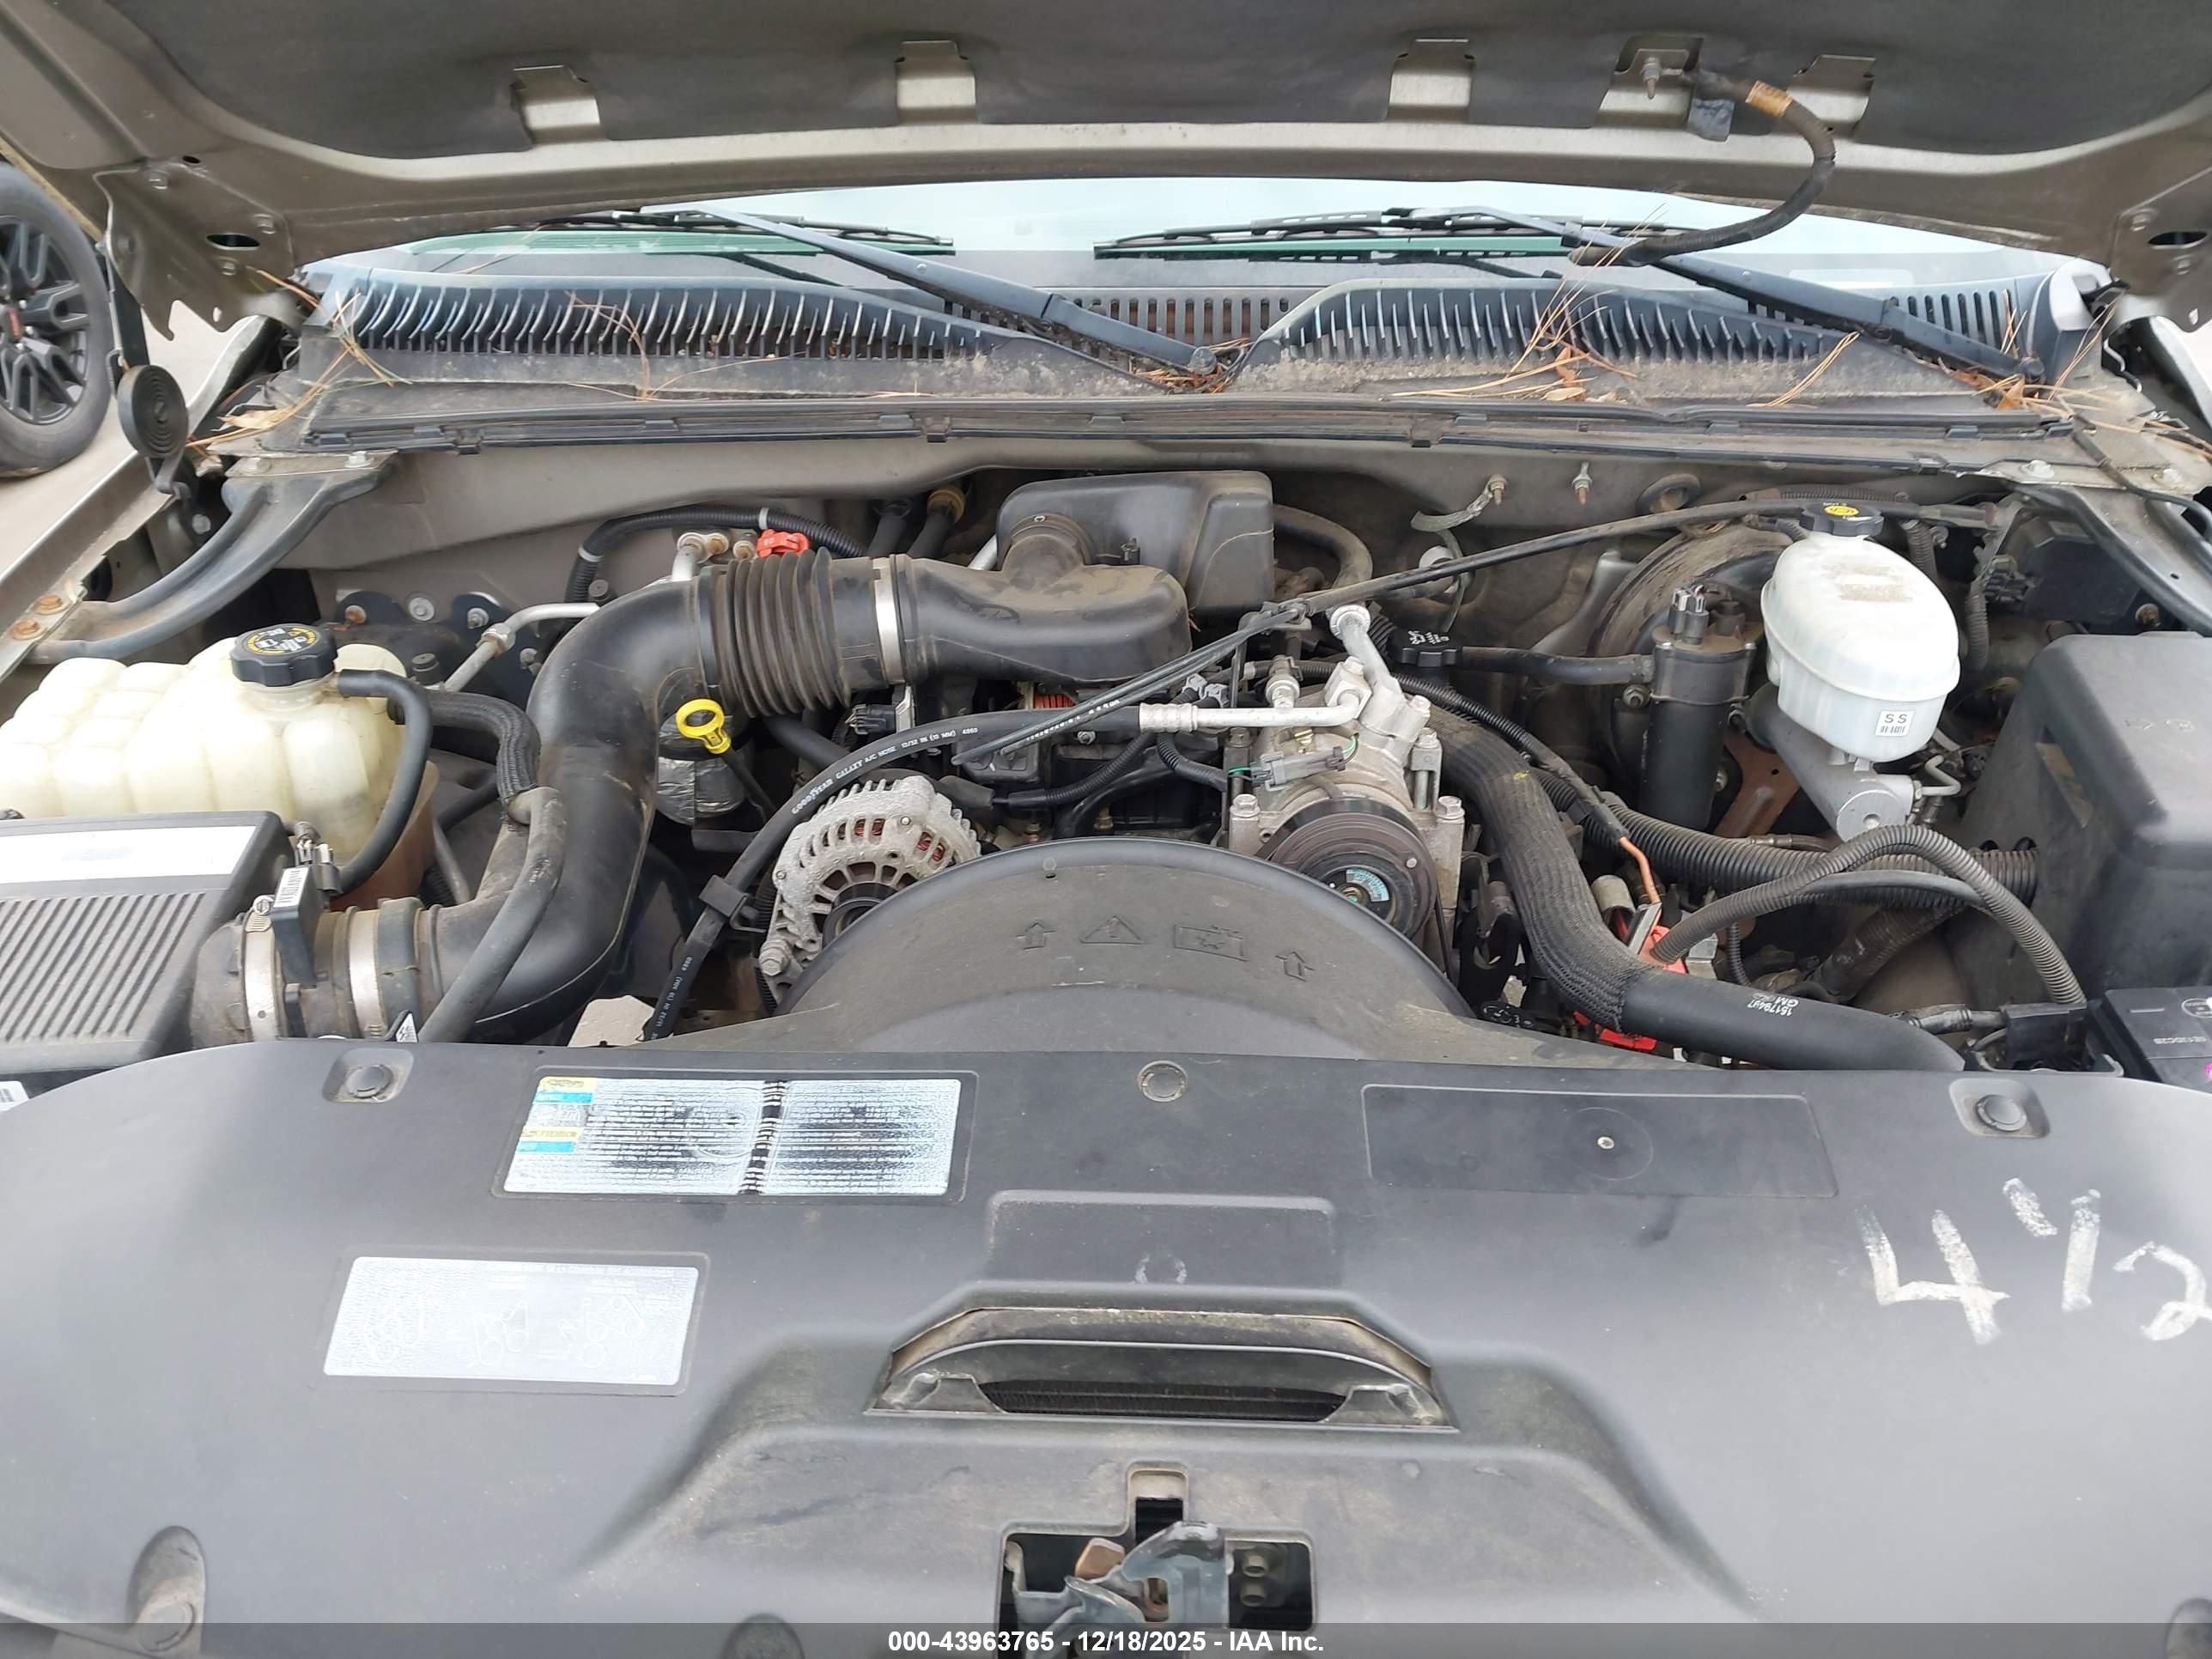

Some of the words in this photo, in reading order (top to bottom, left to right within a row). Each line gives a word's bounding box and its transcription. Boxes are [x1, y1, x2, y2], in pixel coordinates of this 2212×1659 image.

[791, 778, 834, 814] GOODYEAR
[836, 759, 863, 779] GALAXY
[1774, 996, 1799, 1007] GM
